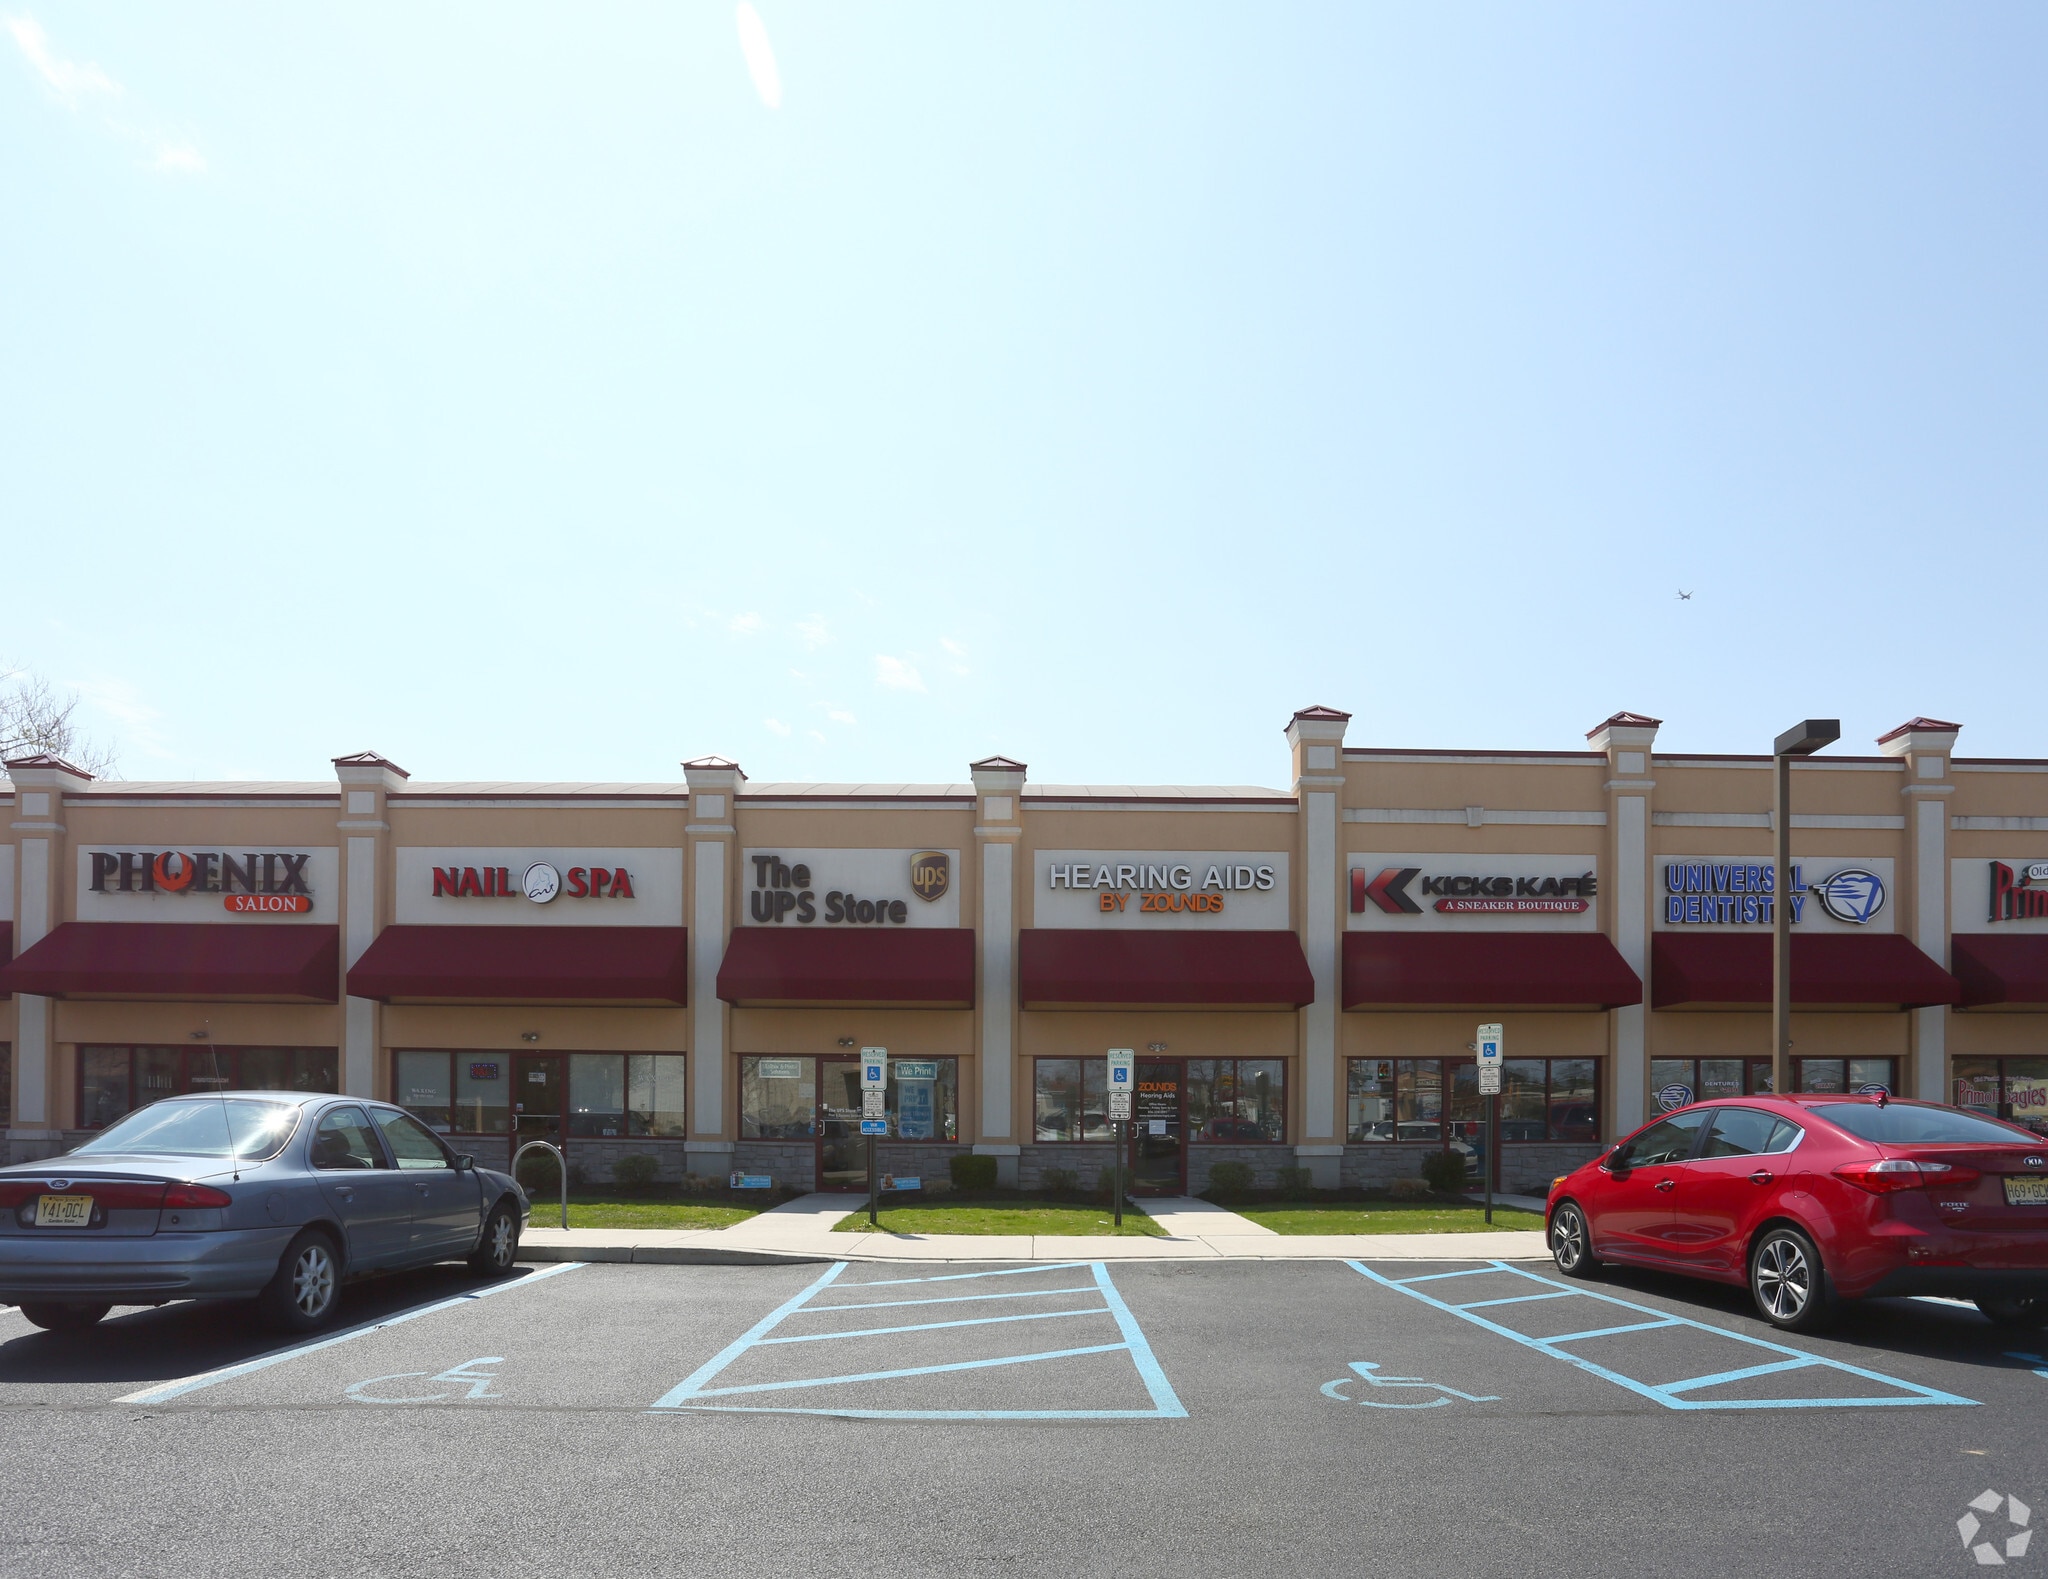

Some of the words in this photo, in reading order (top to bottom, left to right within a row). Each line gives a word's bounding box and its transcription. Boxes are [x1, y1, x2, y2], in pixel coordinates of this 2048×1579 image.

[88, 851, 313, 893] PHOENIX
[432, 867, 516, 897] NAIL
[567, 866, 635, 898] SPA
[751, 856, 811, 888] The
[913, 866, 946, 893] ups
[1050, 864, 1192, 890] HEARING
[1201, 865, 1275, 891] AIDS
[1421, 875, 1513, 896] KICKS
[1516, 870, 1598, 896] KAFÉ
[1667, 863, 1808, 893] UNIVERSL
[235, 896, 297, 912] SALON
[751, 890, 816, 923] UPS
[825, 891, 908, 923] Store
[1100, 893, 1130, 912] BY
[1140, 893, 1224, 912] ZOUNDS
[1445, 901, 1454, 910] A
[1457, 901, 1514, 910] SNEAKER
[1518, 901, 1579, 911] BOUTIQUE
[1667, 895, 1807, 923] DENTISTY
[901, 1066, 912, 1075] We
[914, 1066, 931, 1075] Print
[1138, 1082, 1177, 1092] ZOUNDS
